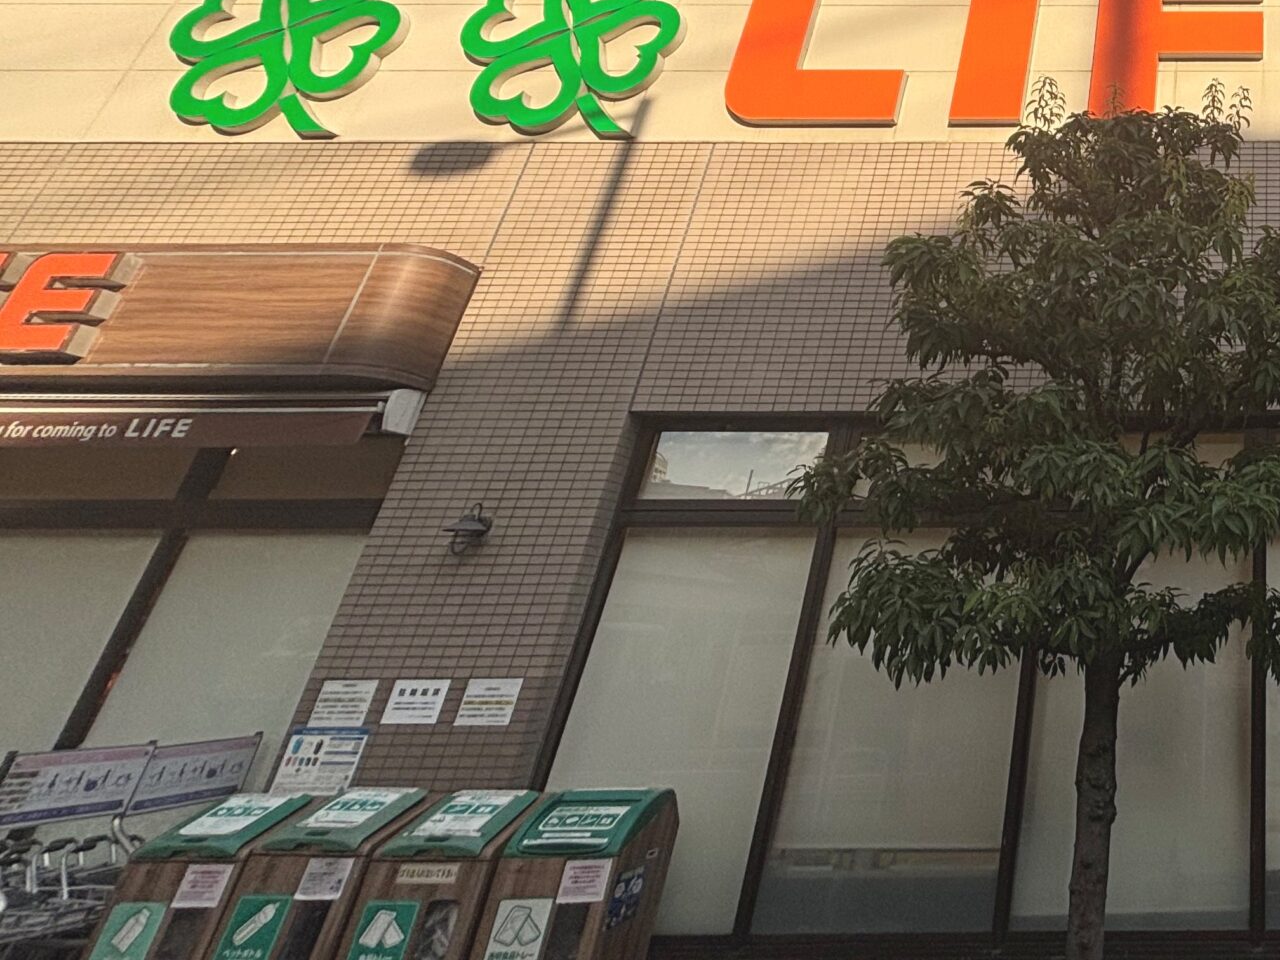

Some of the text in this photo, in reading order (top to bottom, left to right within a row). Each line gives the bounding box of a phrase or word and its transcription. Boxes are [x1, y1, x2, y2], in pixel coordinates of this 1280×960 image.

[3, 417, 193, 442] for coming to LIFE
